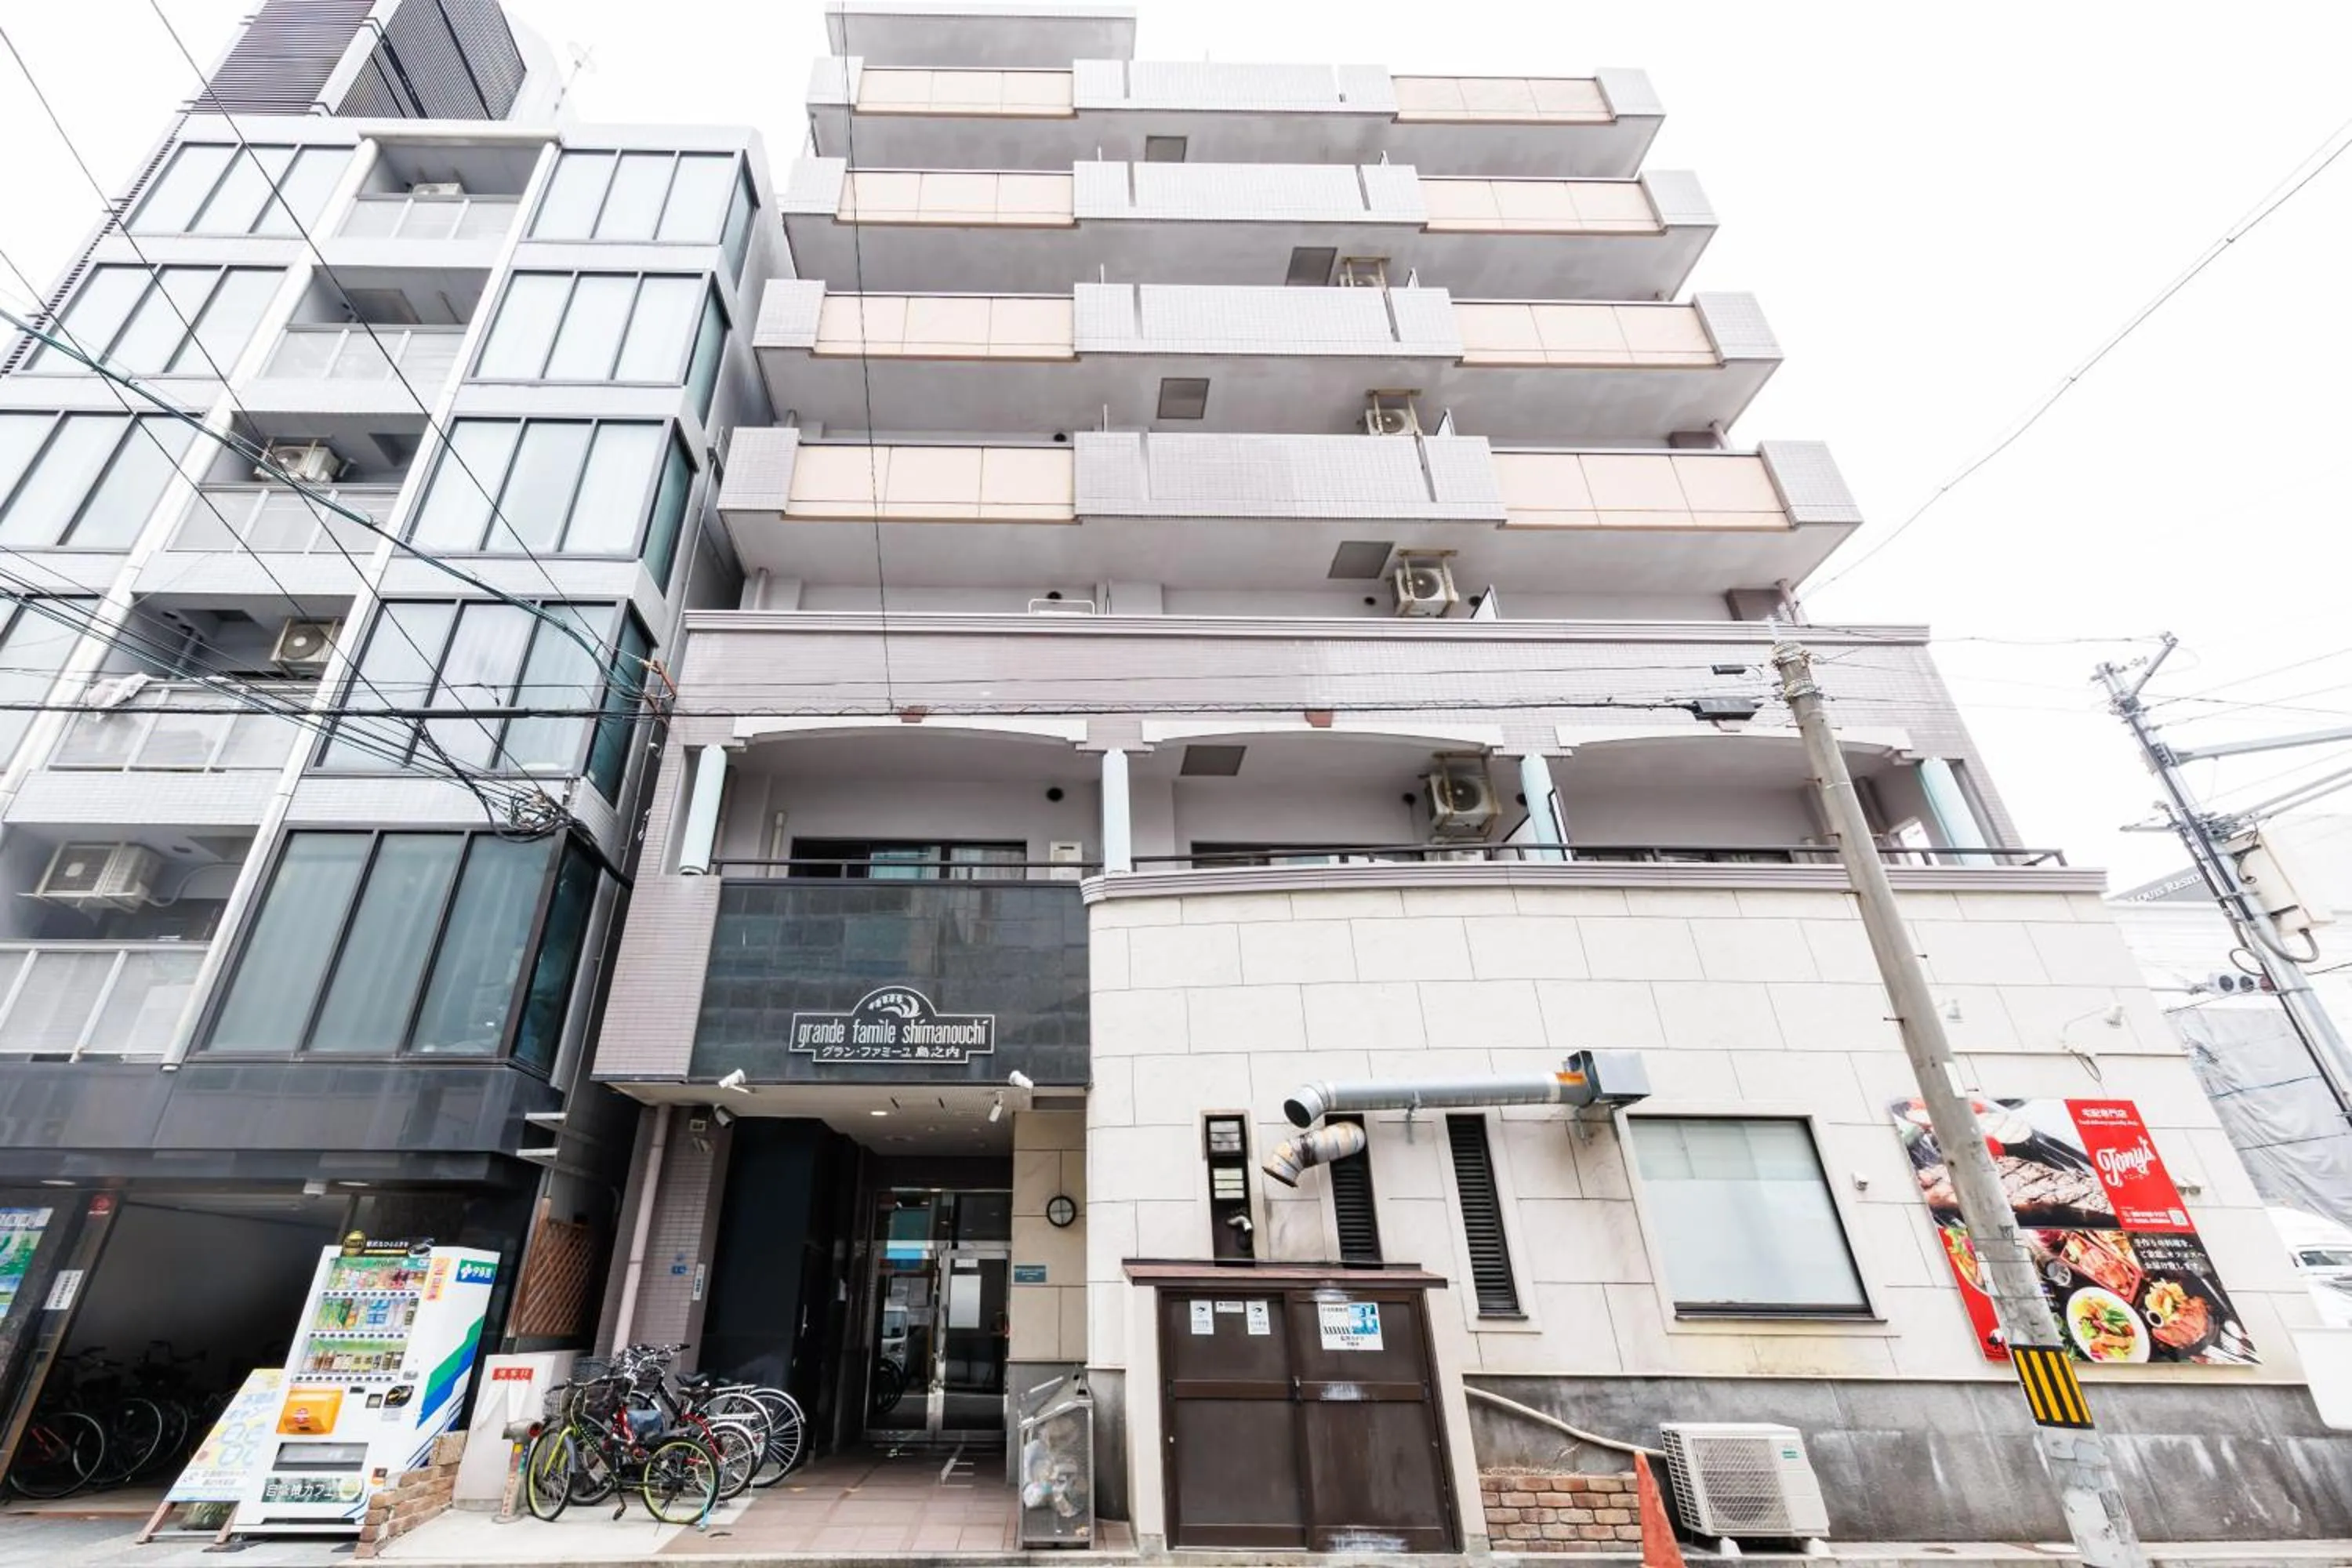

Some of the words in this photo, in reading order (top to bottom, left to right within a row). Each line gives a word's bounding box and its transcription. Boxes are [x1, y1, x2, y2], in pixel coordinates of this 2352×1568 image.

[798, 1019, 844, 1047] grande
[853, 1019, 895, 1044] famile
[902, 1019, 988, 1044] shimanouchi
[2096, 1135, 2156, 1188] Tony's
